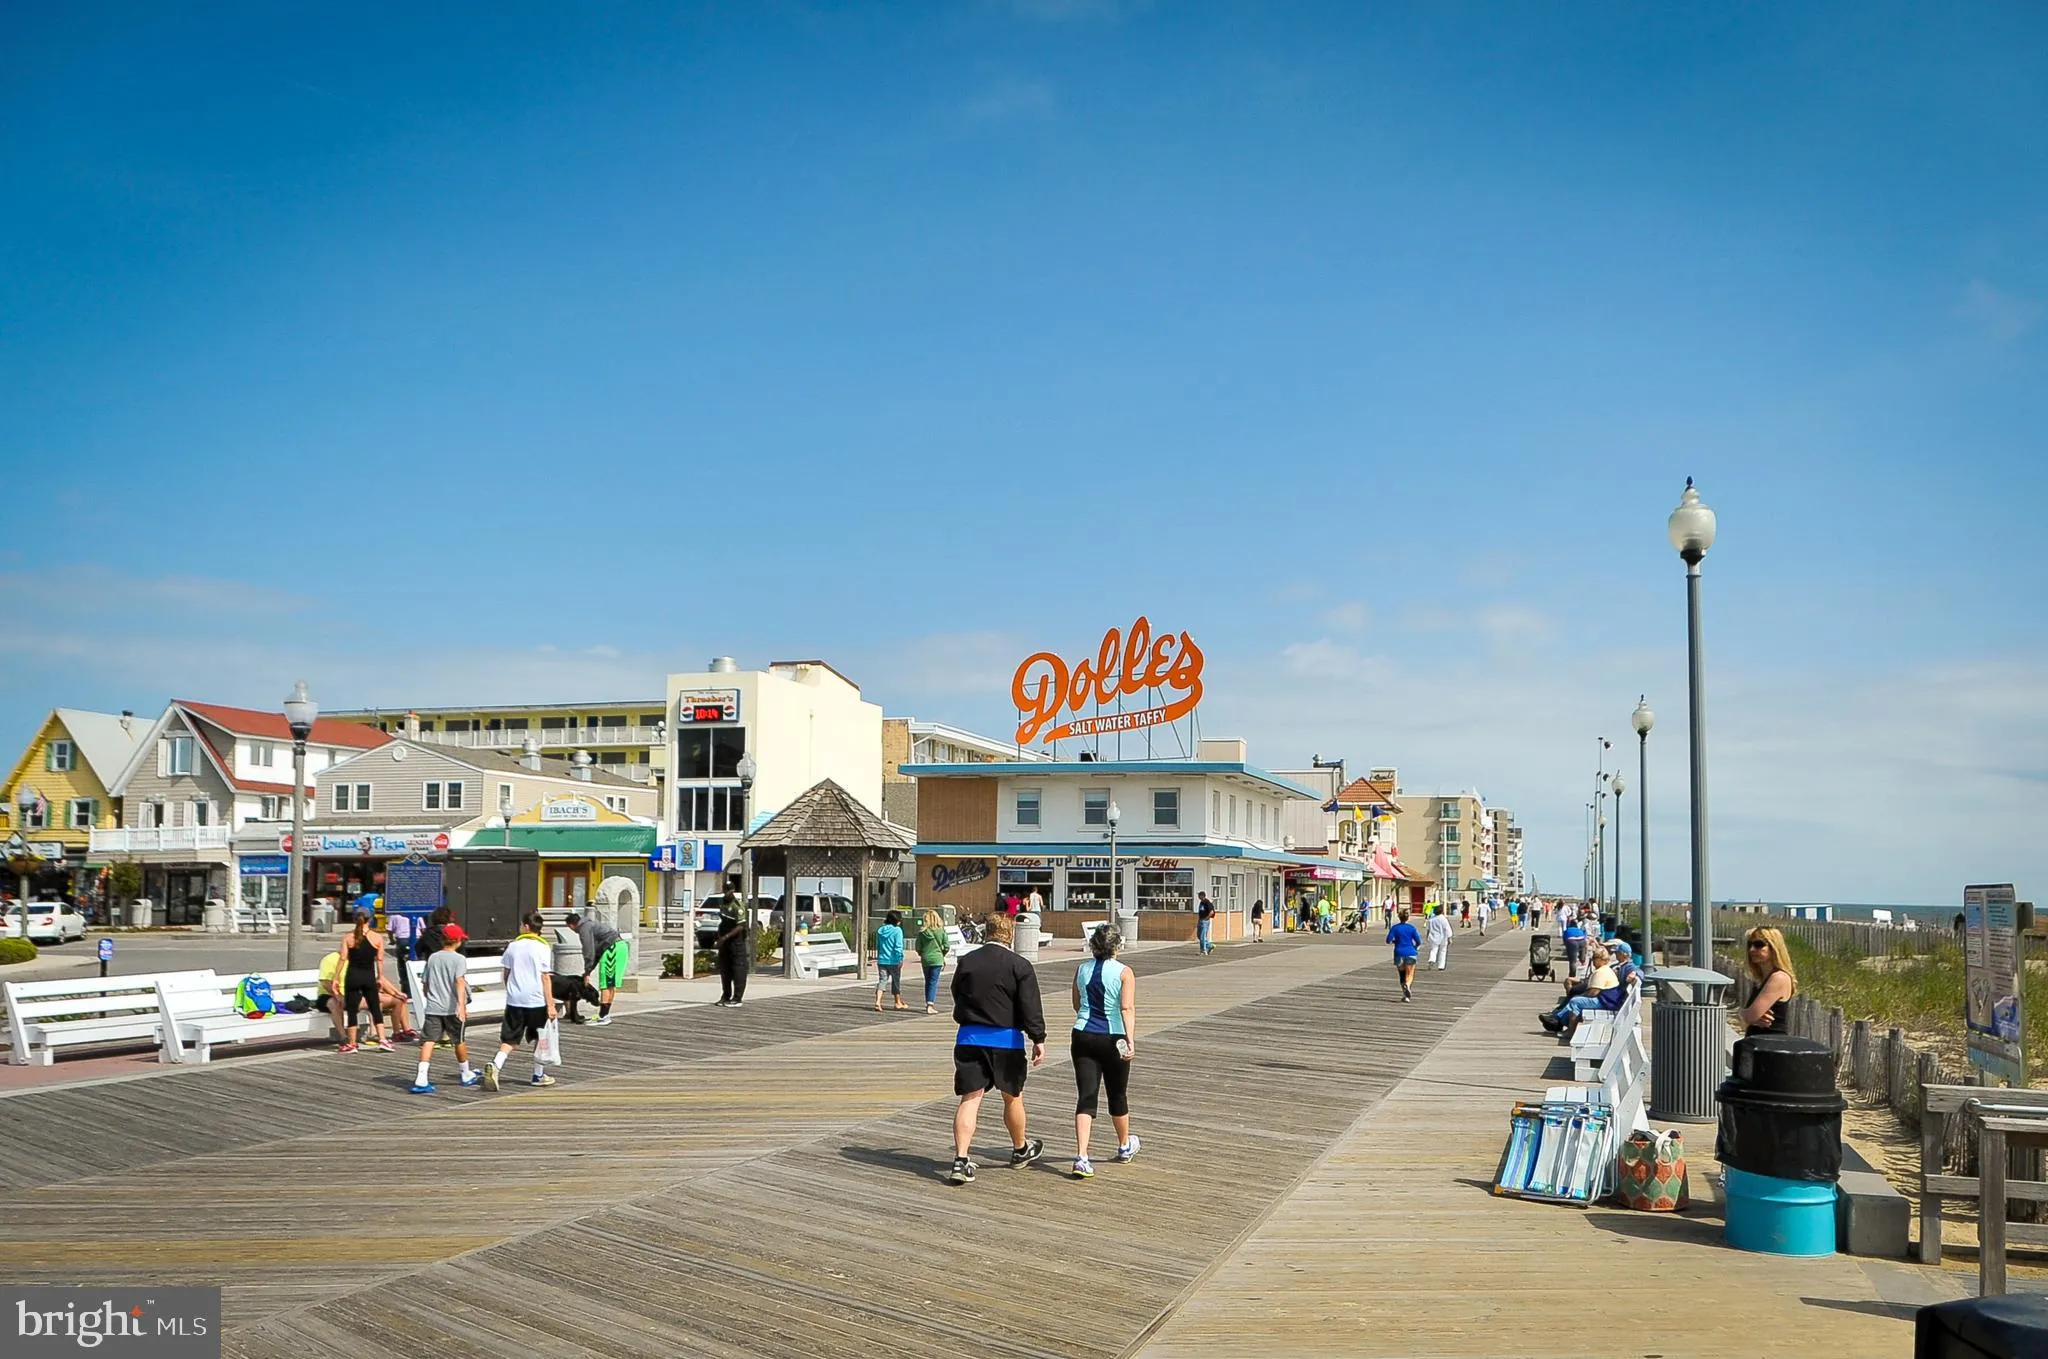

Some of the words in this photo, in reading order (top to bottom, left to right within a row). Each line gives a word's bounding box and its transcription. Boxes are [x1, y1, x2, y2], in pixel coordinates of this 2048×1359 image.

[1068, 720, 1093, 736] SALT
[1094, 714, 1132, 733] WATER
[1133, 709, 1167, 728] TAFFY
[1000, 856, 1042, 867] Fudge
[1047, 857, 1072, 867] POP
[1076, 857, 1110, 867] CORN
[1142, 856, 1179, 870] Taffy
